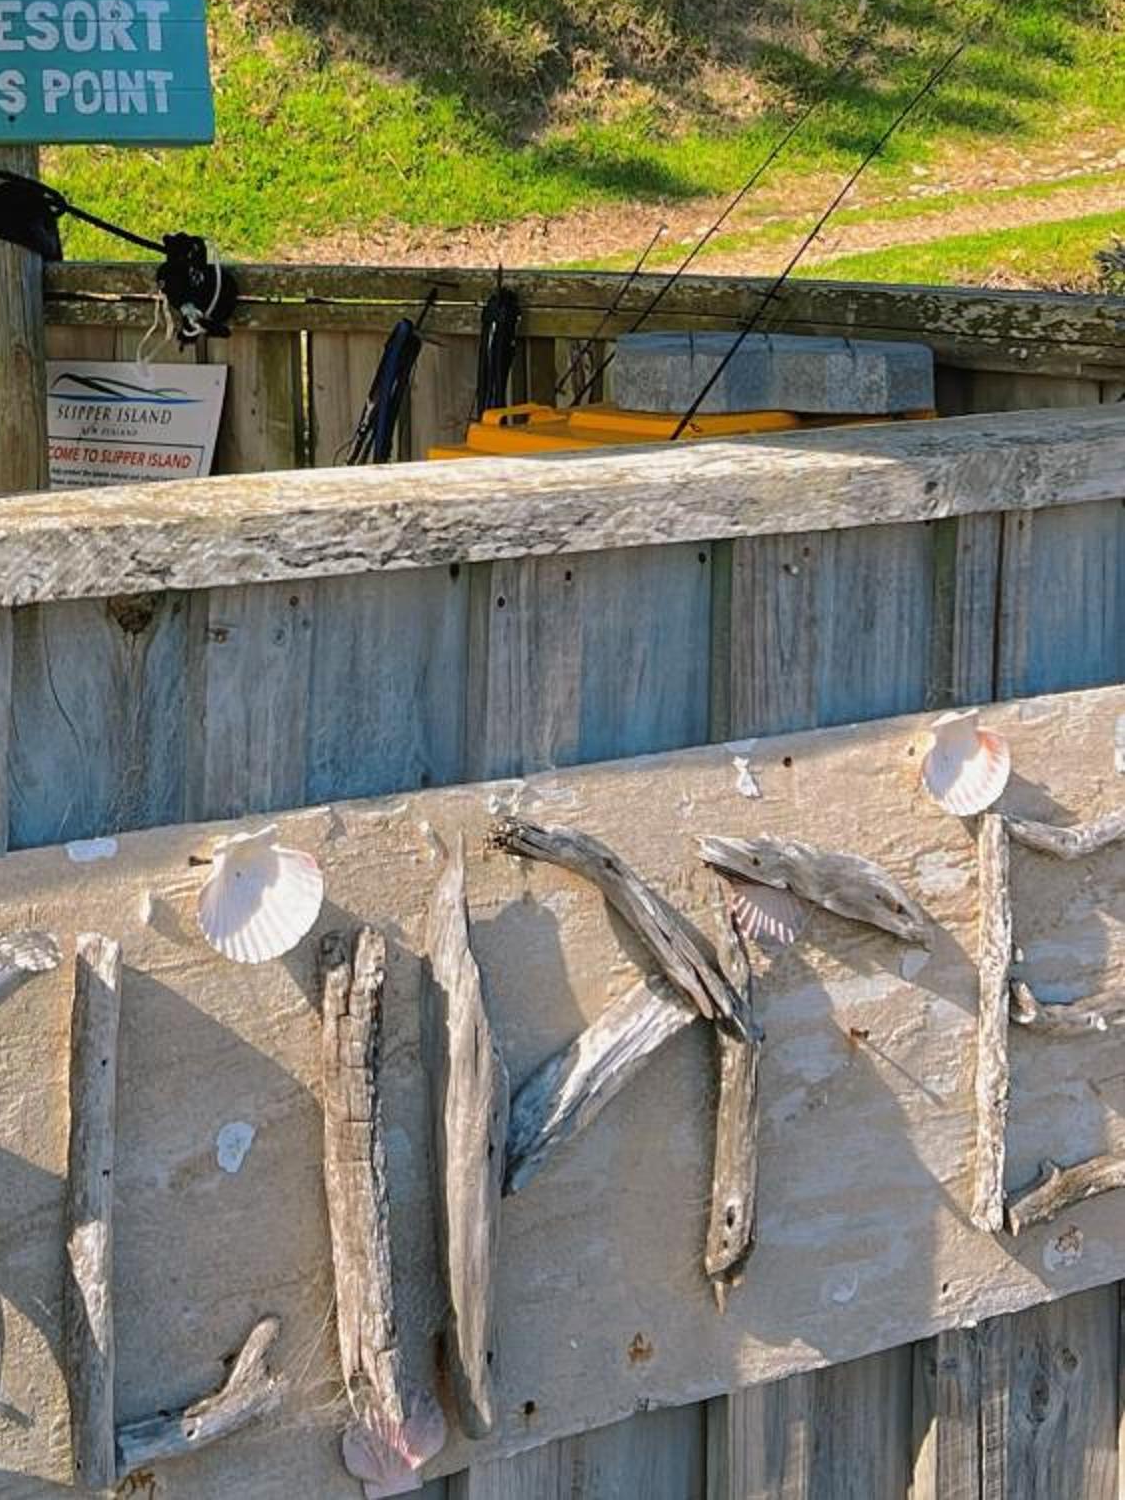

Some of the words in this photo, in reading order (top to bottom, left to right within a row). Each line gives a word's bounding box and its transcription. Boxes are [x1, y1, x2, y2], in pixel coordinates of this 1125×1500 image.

[43, 69, 174, 114] POINT
[58, 404, 112, 421] SLIPPER
[116, 407, 172, 425] ISLAND
[83, 447, 99, 463] TO
[100, 449, 146, 466] SLIPPER
[147, 452, 192, 469] ISLAND
